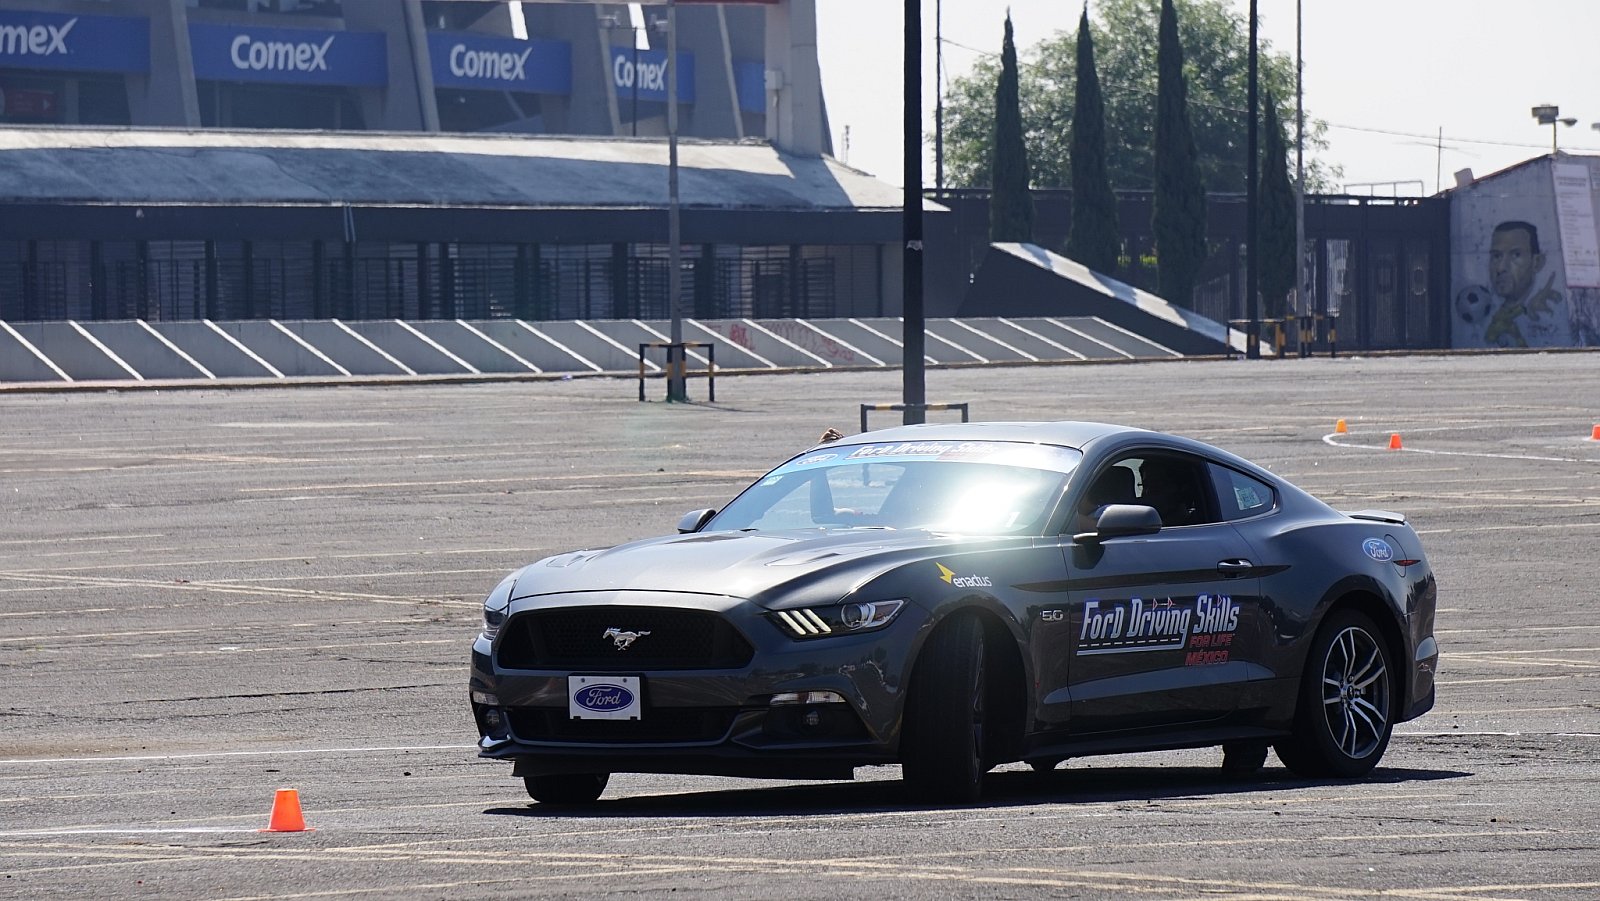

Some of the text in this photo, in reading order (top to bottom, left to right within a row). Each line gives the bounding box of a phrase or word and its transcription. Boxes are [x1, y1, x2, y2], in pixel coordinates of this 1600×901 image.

[231, 34, 335, 72] Comex
[449, 43, 533, 82] Comex
[614, 54, 669, 91] Comex
[1368, 541, 1389, 558] Ford
[953, 574, 993, 587] enactus
[1126, 597, 1191, 645] Driving
[1192, 594, 1240, 633] Skills
[1190, 633, 1233, 648] FOR LIFE
[1184, 649, 1229, 666] MÉXICO
[585, 687, 621, 706] Ford
